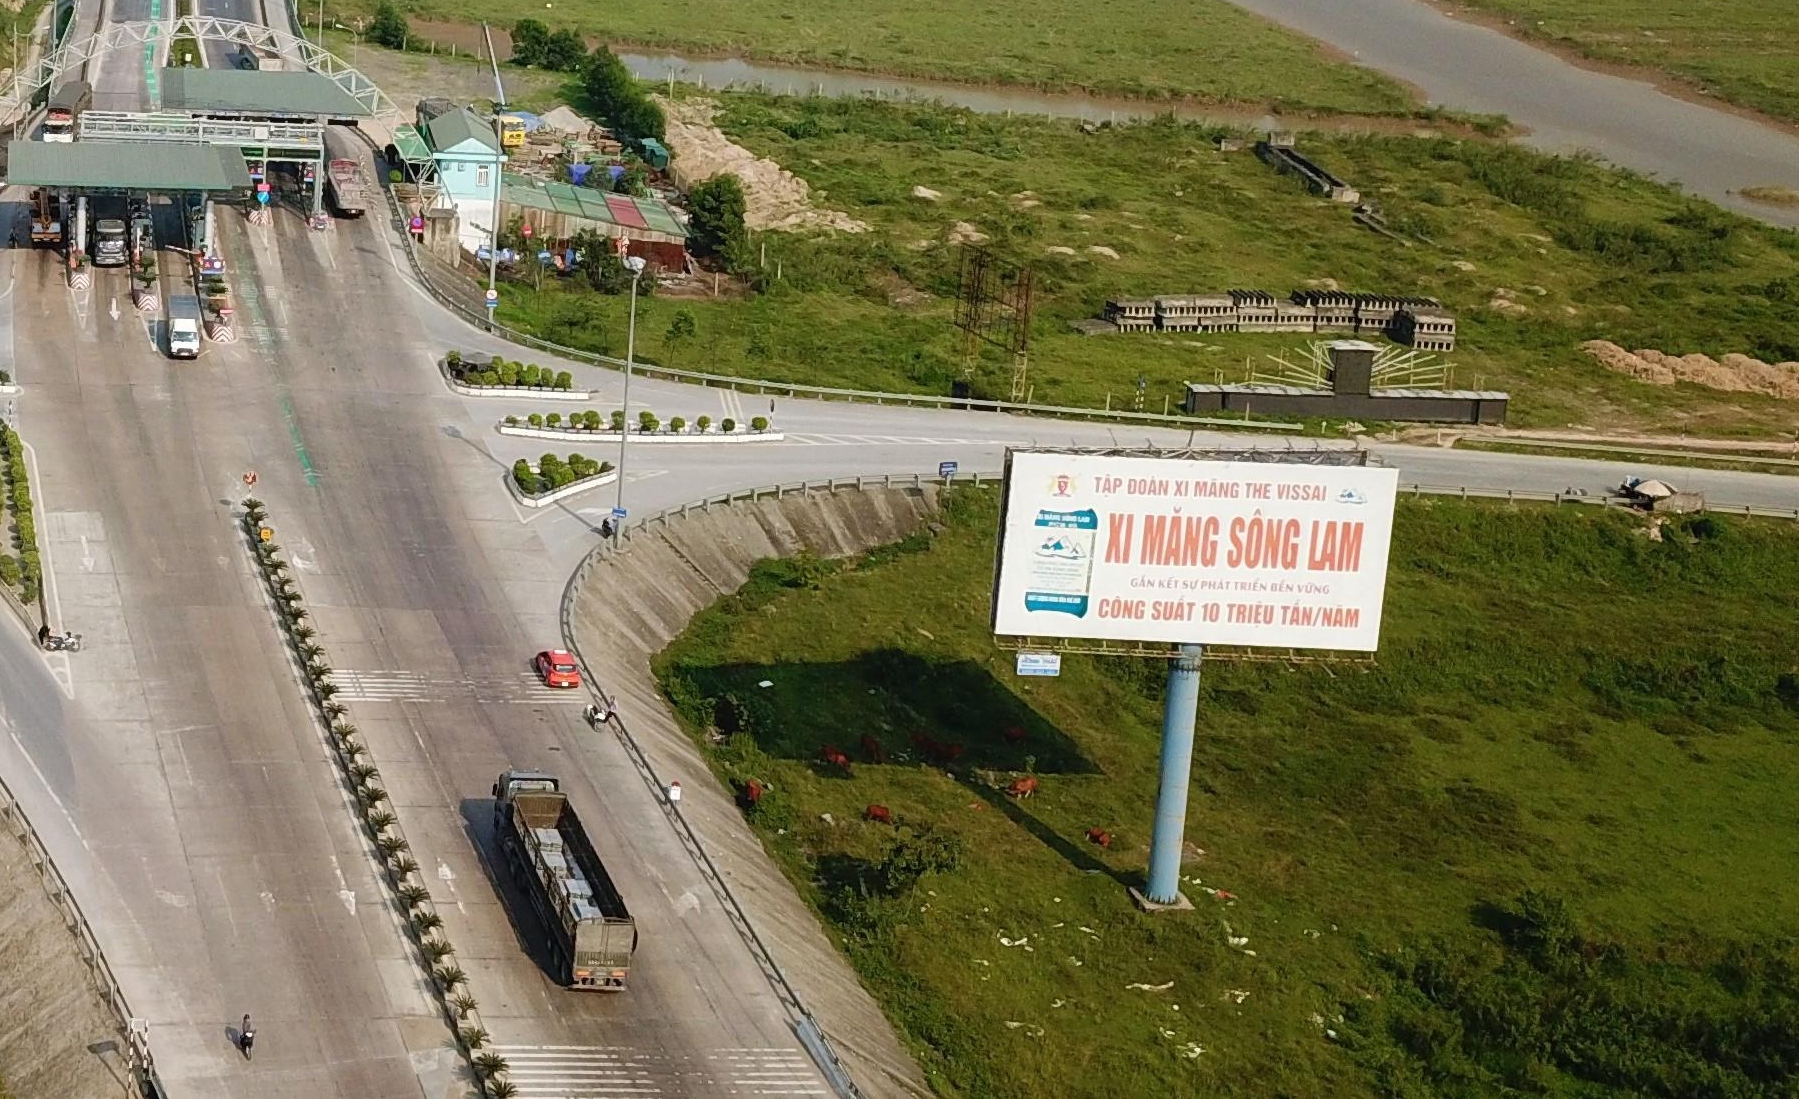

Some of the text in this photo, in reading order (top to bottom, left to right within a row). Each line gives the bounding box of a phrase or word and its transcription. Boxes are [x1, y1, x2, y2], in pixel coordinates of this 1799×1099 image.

[1095, 474, 1123, 498] TẬP
[1127, 475, 1169, 496] ĐOÀN
[1173, 481, 1189, 497] XI
[1244, 483, 1272, 500] THE
[1276, 484, 1327, 501] VISSAI
[1105, 512, 1135, 564] XI
[1140, 506, 1220, 567] MĂNG
[1227, 508, 1301, 570] SÔNG
[1307, 520, 1364, 572] LAM
[1098, 595, 1360, 628] CÔNG SUẤT 10 TRIỆU TẤN/NĂM
